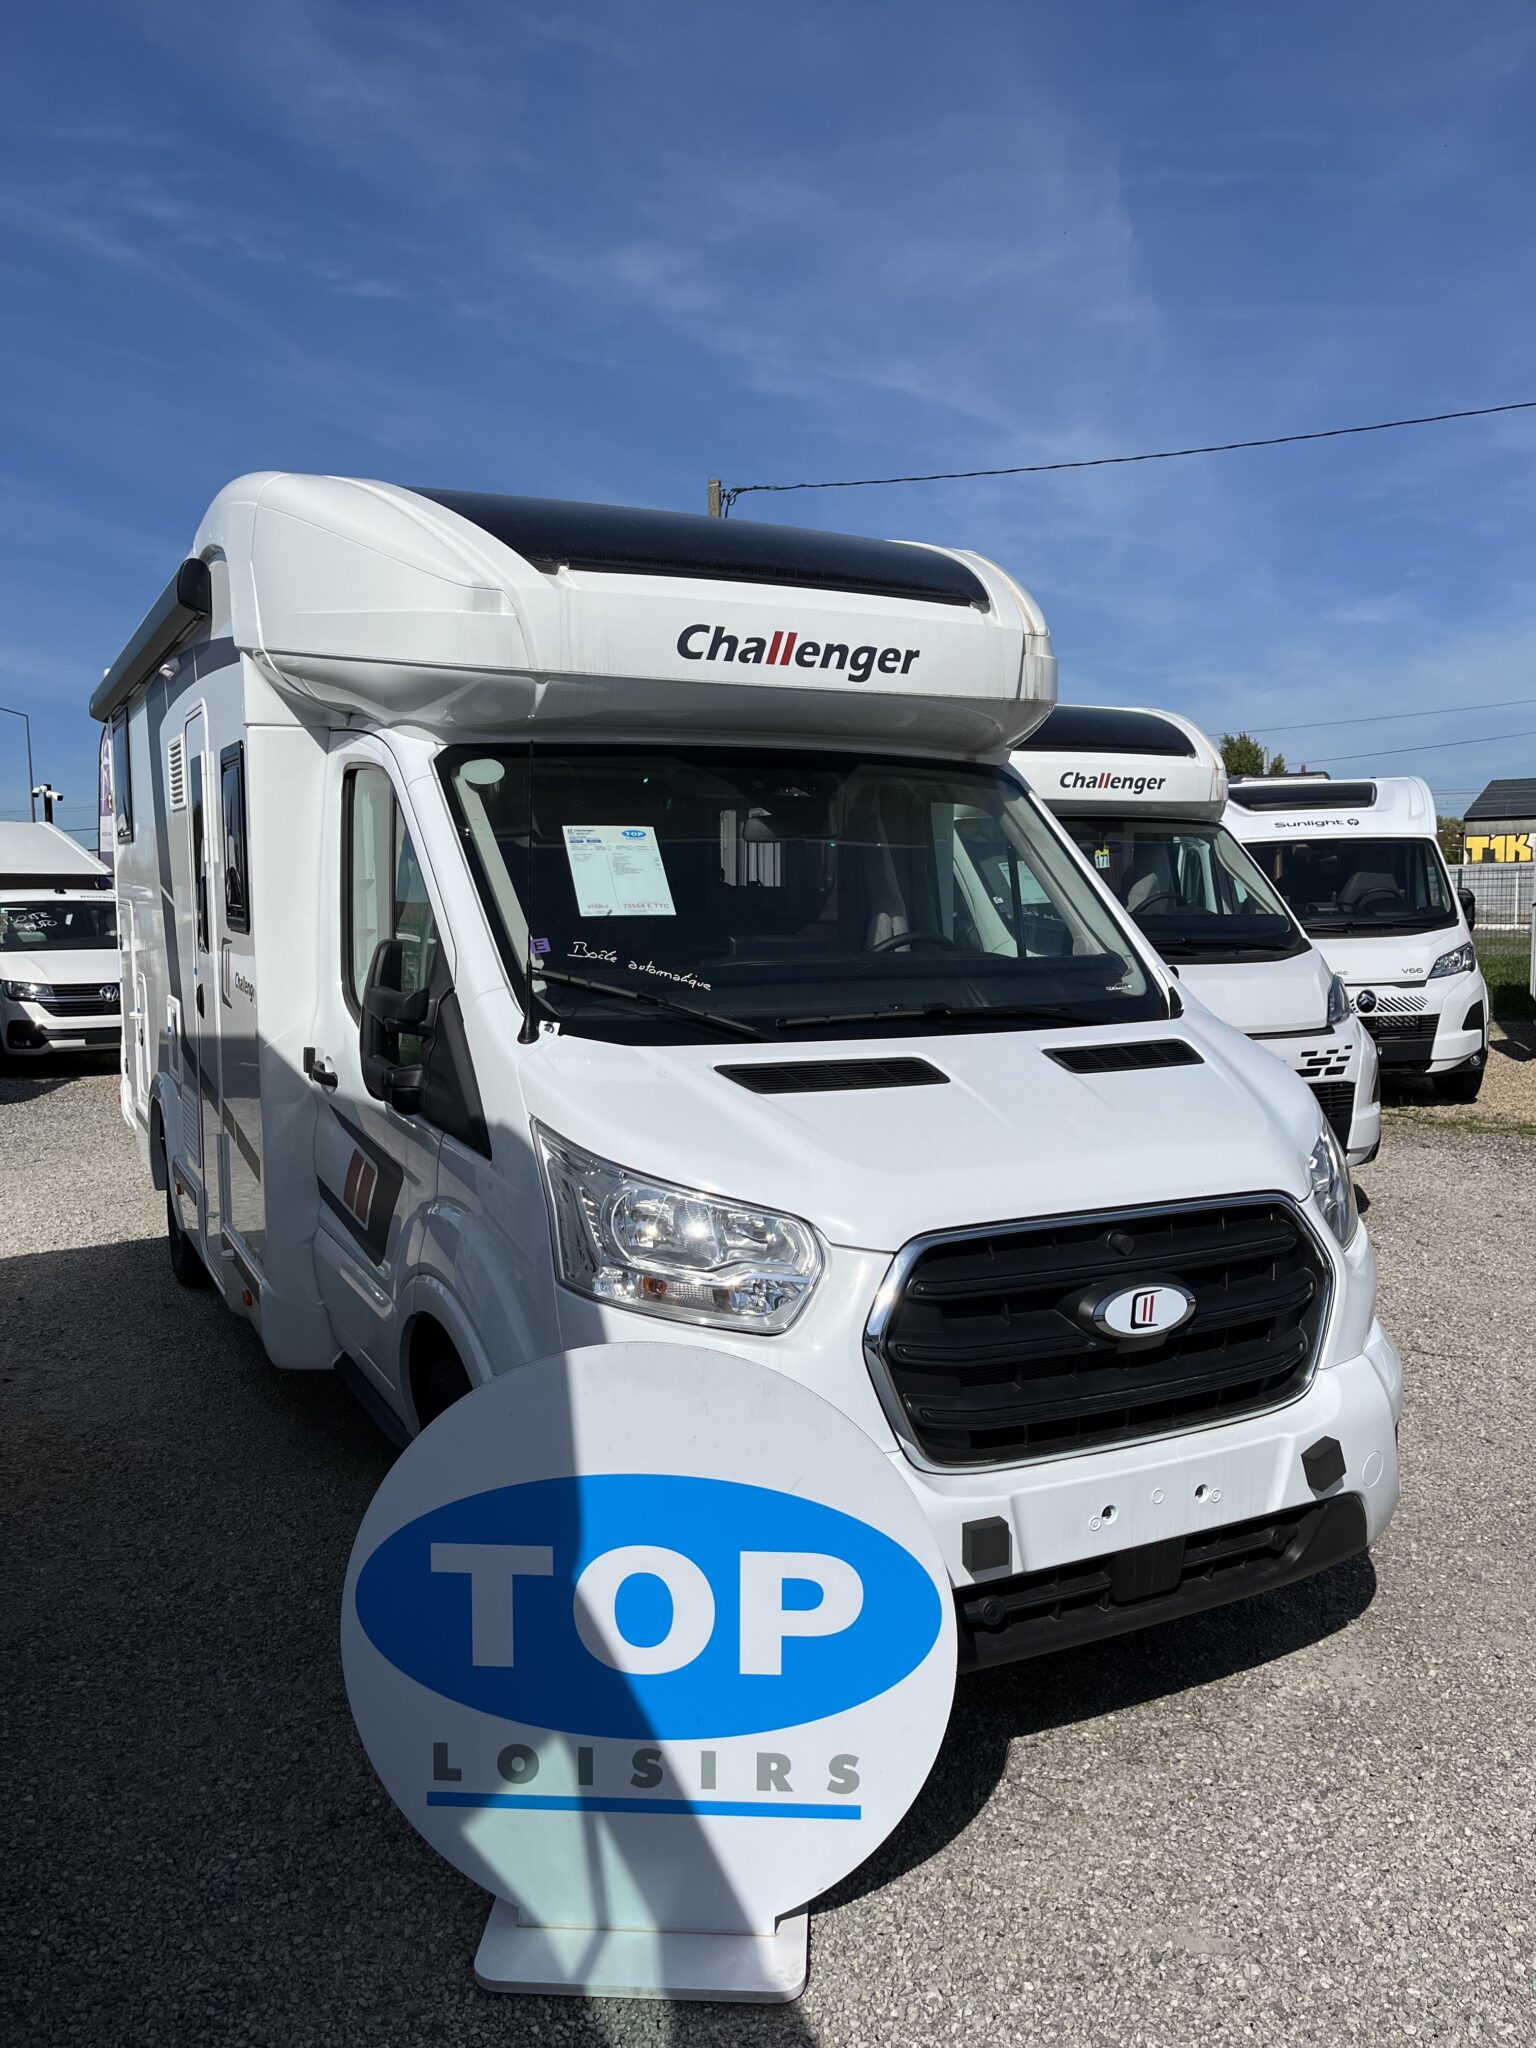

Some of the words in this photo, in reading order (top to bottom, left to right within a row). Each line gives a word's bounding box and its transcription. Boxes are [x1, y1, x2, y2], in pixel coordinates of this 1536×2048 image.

[676, 624, 920, 683] Challenger
[1059, 771, 1166, 795] Challenger
[1274, 819, 1345, 828] Sunlight
[628, 960, 712, 992] automatique
[430, 1542, 864, 1676] TOP
[432, 1741, 861, 1795] LOISIRS
